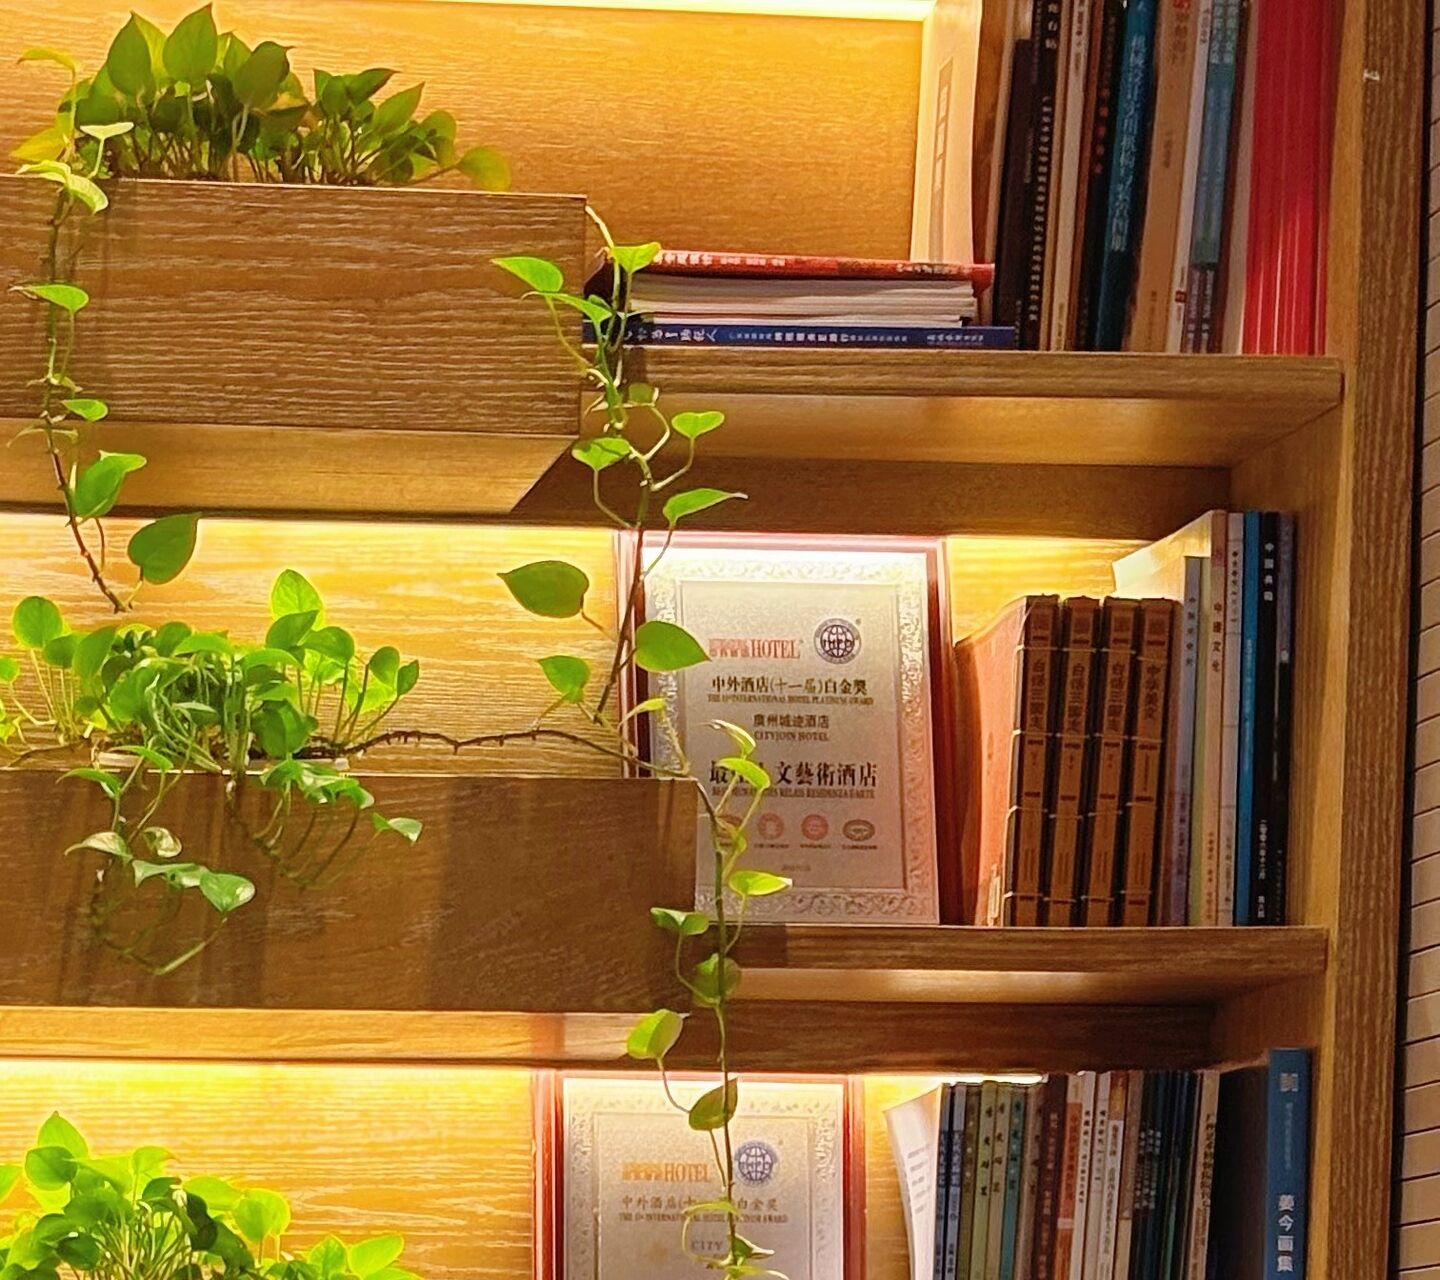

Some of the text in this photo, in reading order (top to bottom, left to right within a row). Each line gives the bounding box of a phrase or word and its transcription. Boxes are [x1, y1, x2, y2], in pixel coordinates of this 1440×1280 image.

[751, 638, 801, 660] HOTEL
[665, 1162, 709, 1182] HOTEL
[690, 1239, 723, 1251] CITY
